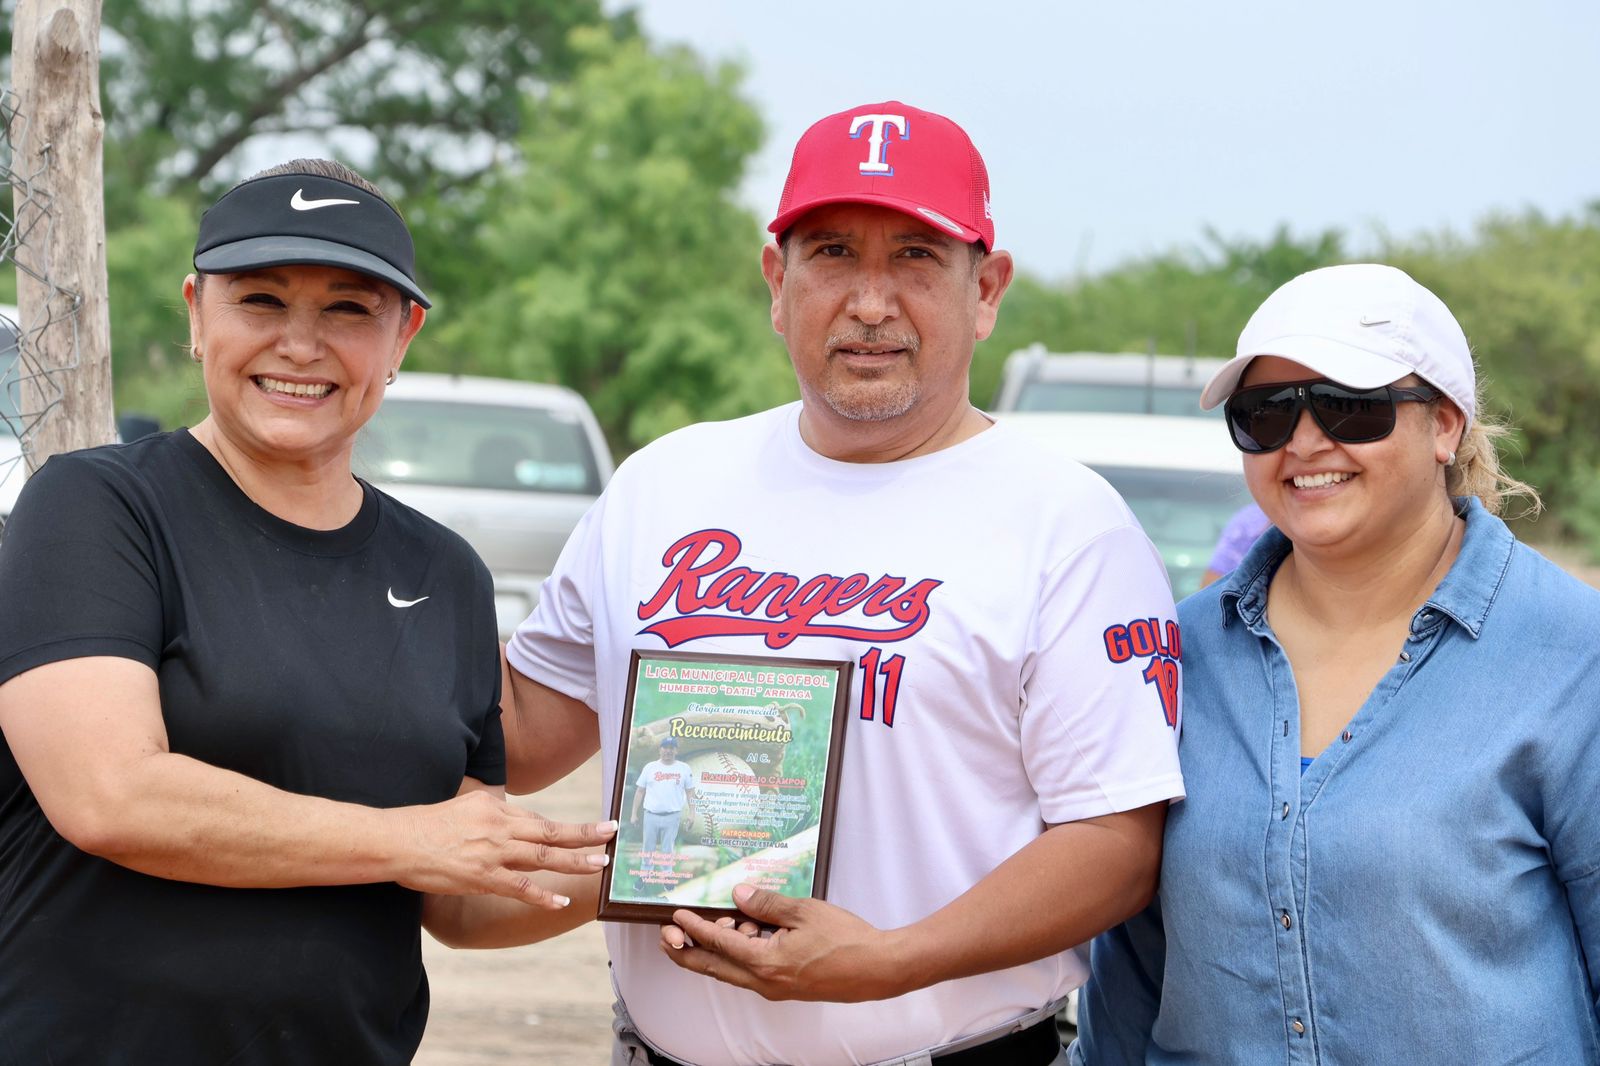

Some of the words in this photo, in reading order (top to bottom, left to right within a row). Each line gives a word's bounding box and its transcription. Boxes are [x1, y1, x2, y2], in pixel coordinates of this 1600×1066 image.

[849, 114, 910, 177] T
[636, 528, 944, 650] Rangers
[645, 665, 677, 679] LIGA
[681, 668, 754, 684] MUNICIPAL
[757, 672, 775, 684] DE
[777, 673, 830, 687] SOFBOL
[858, 646, 906, 729] 11
[659, 683, 719, 695] HUMBERTO
[763, 689, 812, 699] ARRIAGA
[669, 717, 793, 743] Reconocimiento
[718, 838, 749, 847] DIRECTIVA
[722, 829, 770, 839] PATROCINADOR
